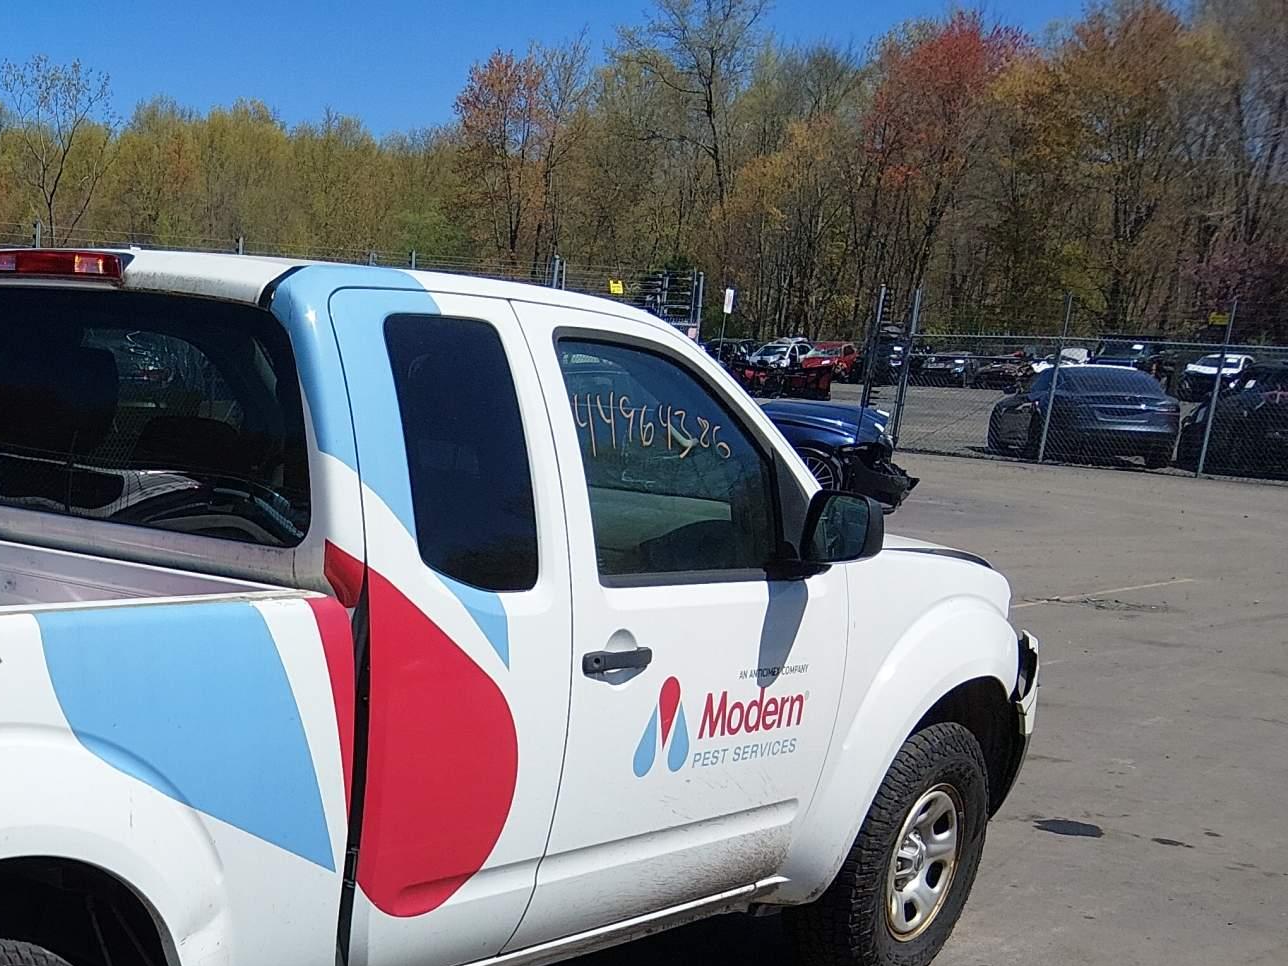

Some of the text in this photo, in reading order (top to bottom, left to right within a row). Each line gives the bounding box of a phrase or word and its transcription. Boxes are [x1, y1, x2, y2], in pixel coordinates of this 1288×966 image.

[739, 669, 748, 680] AN
[782, 663, 810, 676] COMPANY
[692, 738, 798, 769] PEST SERVICES
